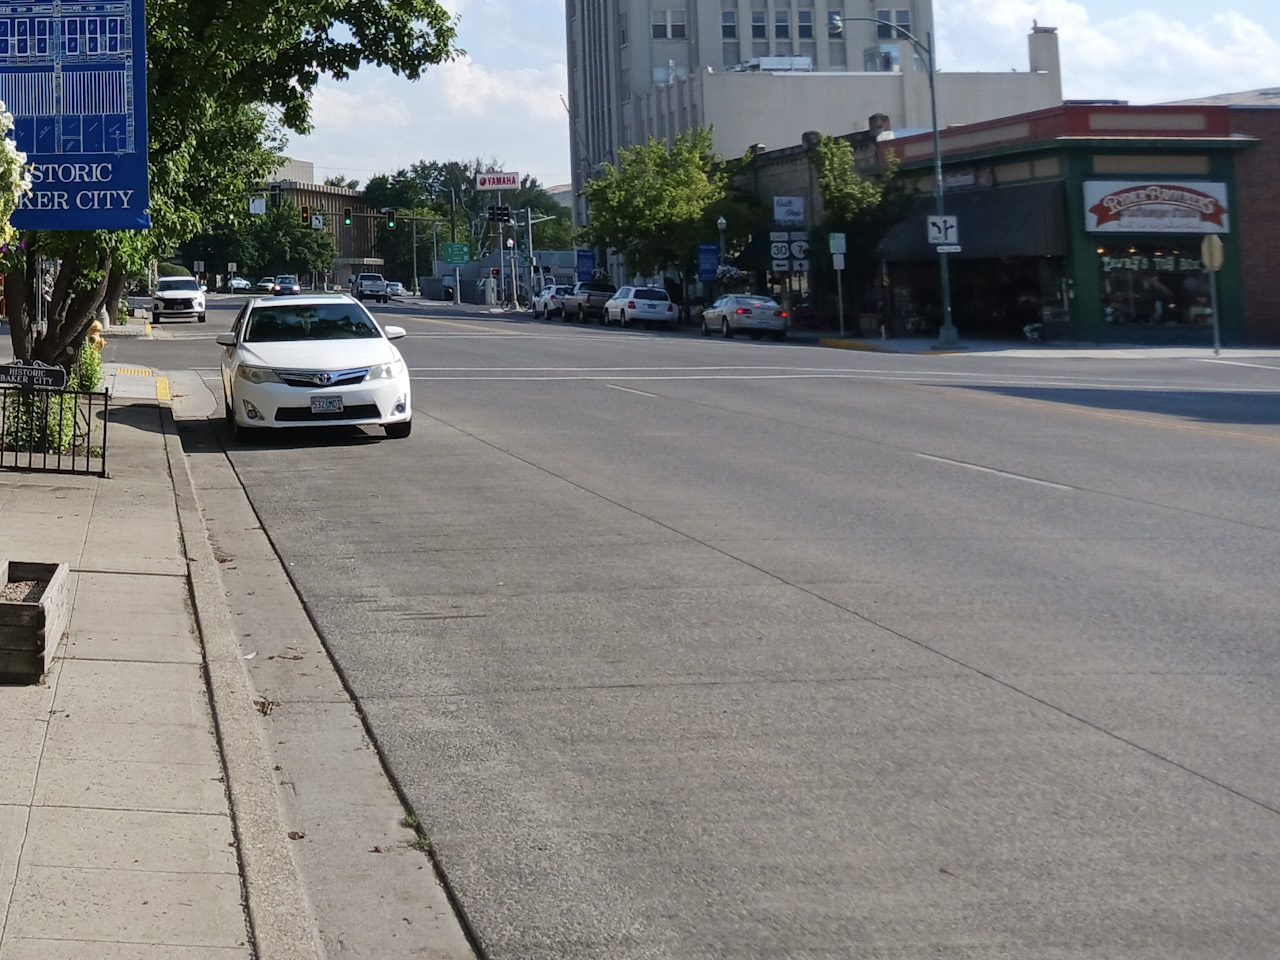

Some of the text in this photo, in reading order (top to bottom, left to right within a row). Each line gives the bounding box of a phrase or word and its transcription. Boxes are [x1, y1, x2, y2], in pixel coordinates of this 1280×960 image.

[24, 163, 113, 182] STORIC
[487, 176, 517, 186] YAMAHA
[17, 190, 134, 210] KER CITY
[772, 245, 788, 256] 30
[797, 245, 804, 255] 7
[9, 367, 46, 378] HISTORIC
[0, 374, 54, 385] BAKER CITY
